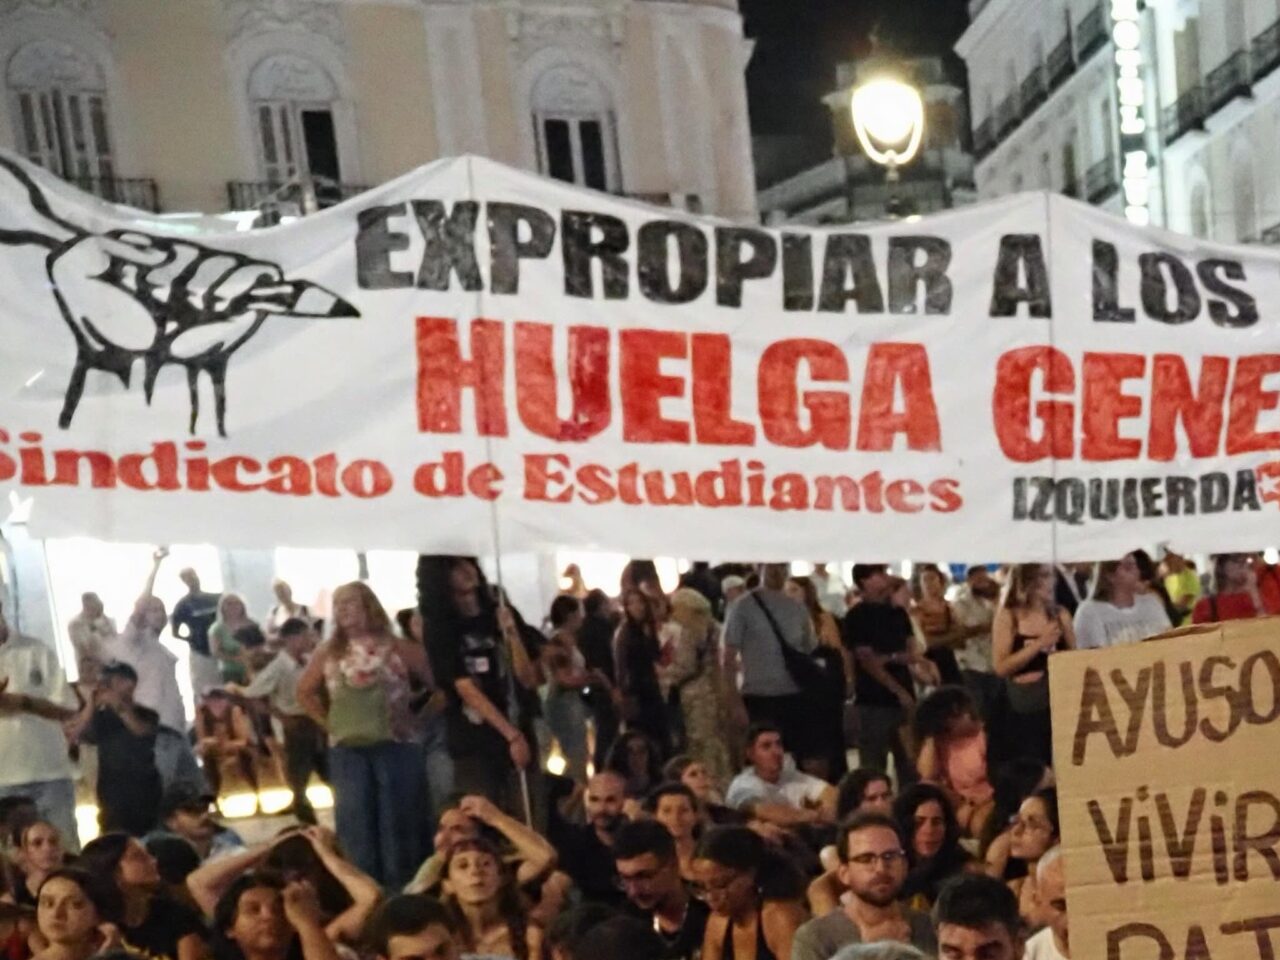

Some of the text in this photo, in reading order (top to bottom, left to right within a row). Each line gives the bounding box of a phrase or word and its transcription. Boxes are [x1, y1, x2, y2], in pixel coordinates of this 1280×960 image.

[355, 199, 953, 315] EXPROPIAR
[989, 233, 1052, 318] A
[1092, 238, 1258, 328] LOS
[415, 316, 942, 454] HUELGA
[414, 452, 503, 500] de
[523, 453, 964, 517] Estudiantes
[1013, 470, 1261, 525] IZQUIERDA
